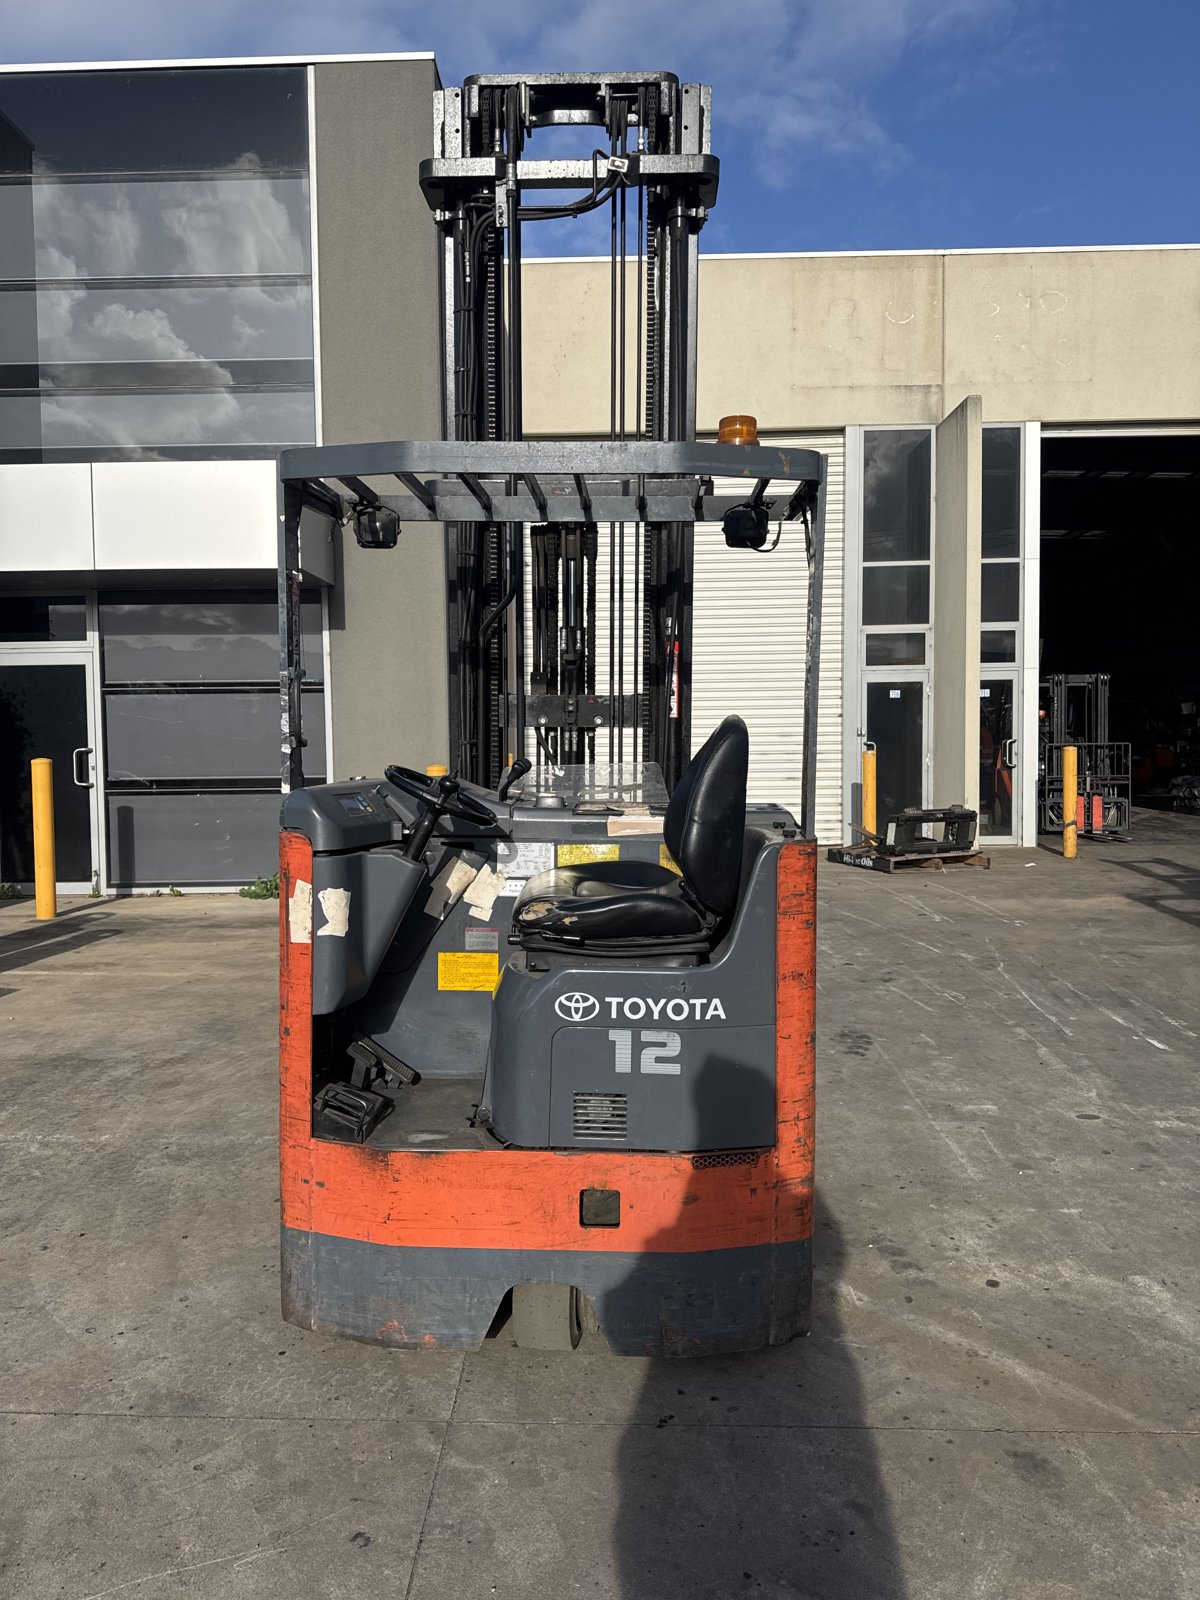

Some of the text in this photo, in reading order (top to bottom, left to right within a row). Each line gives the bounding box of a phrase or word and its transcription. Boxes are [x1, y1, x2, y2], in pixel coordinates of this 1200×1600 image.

[860, 857, 874, 867] Oils
[605, 997, 727, 1021] TOYOTA
[608, 1029, 682, 1075] 12
